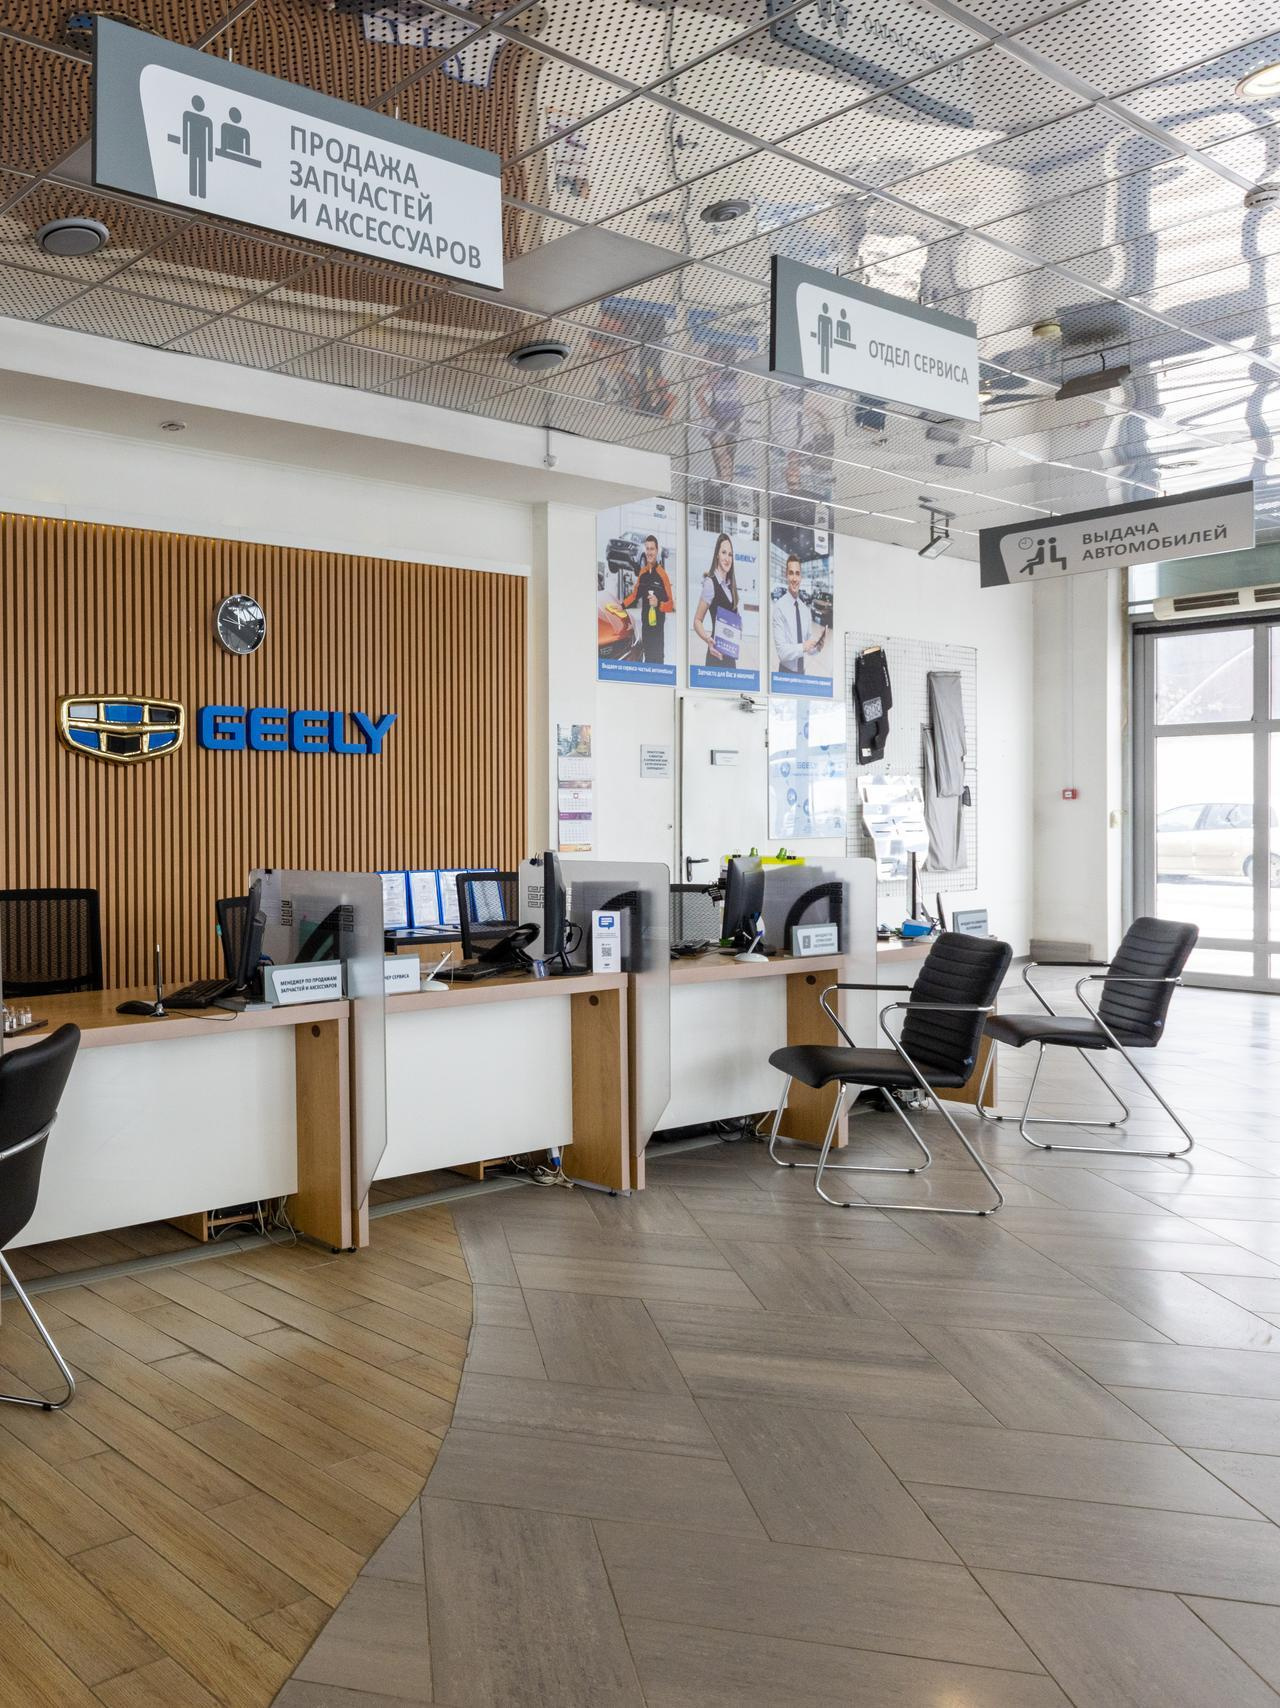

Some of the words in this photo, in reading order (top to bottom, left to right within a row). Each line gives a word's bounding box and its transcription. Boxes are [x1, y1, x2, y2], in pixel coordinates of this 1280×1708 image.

[290, 125, 419, 189] ПРОДАЖА
[289, 160, 433, 225] ЗАПЧАСТЕЙ
[290, 195, 306, 224] И
[316, 203, 481, 269] АКСЕССУАРОВ
[868, 339, 910, 370] ОТДЕЛ
[914, 352, 969, 385] СЕРВИСА
[1082, 521, 1159, 545] ВЫДАЧА
[1083, 523, 1228, 562] АВТОМОБИЛЕЙ
[196, 704, 399, 755] GEELY
[280, 985, 305, 994] ЗАПЧАСТЕЙ
[310, 983, 337, 991] АКСЕССУАРОВ
